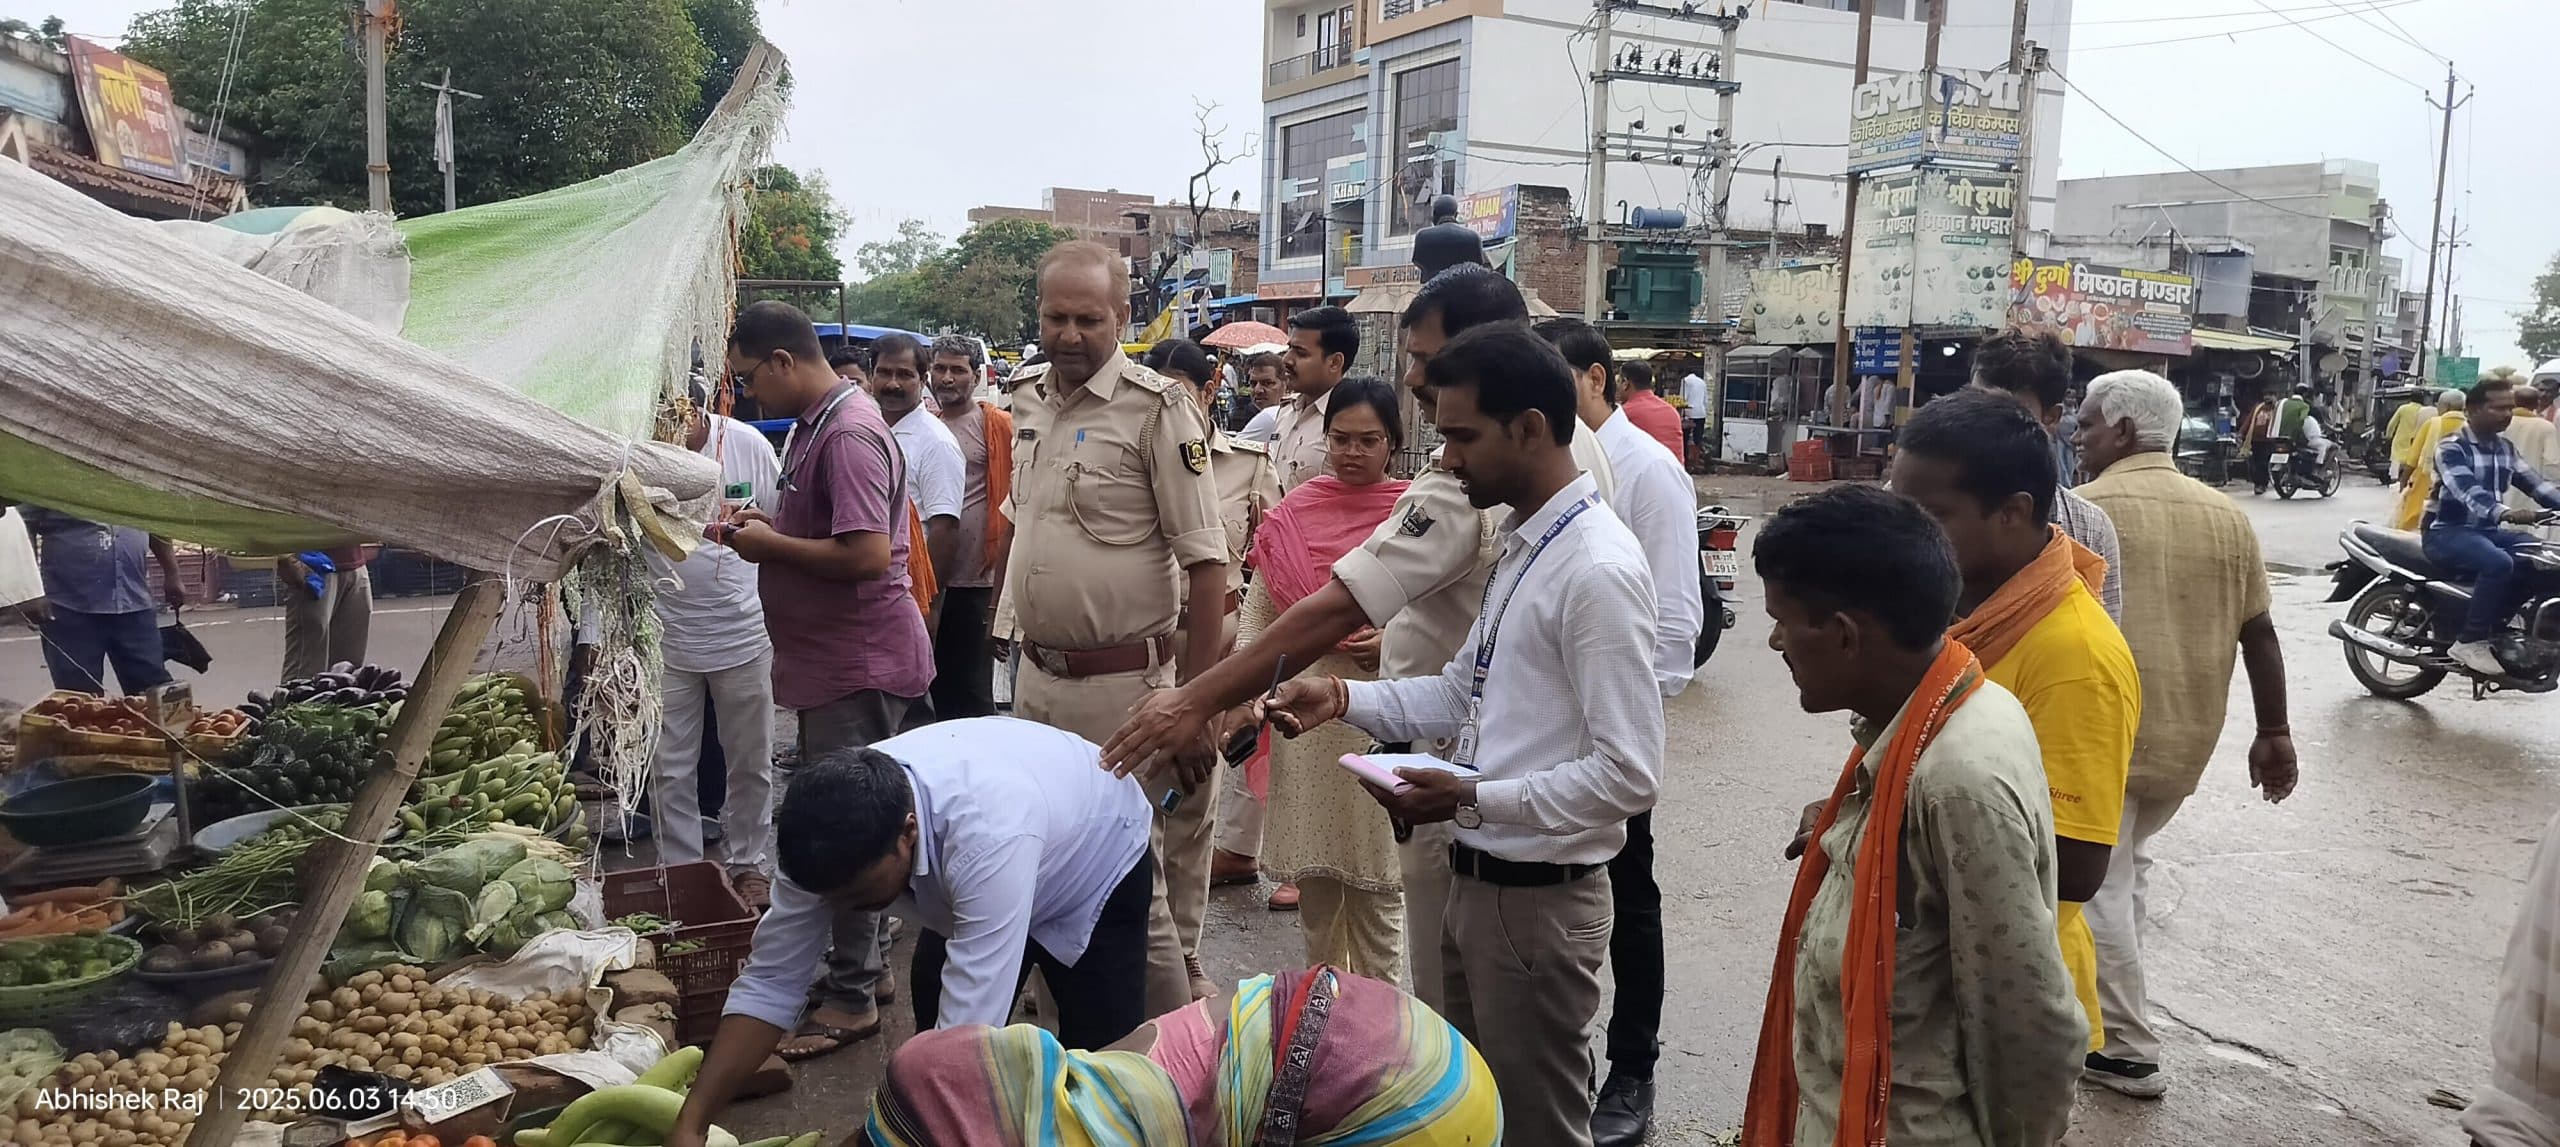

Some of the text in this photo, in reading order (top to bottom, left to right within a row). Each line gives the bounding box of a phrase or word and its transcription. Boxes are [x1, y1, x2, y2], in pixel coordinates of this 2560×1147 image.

[2013, 257, 2035, 286] श्री
[2034, 261, 2072, 295] दुर्गा
[2140, 278, 2192, 305] भण्डार
[2048, 787, 2082, 804] Shree
